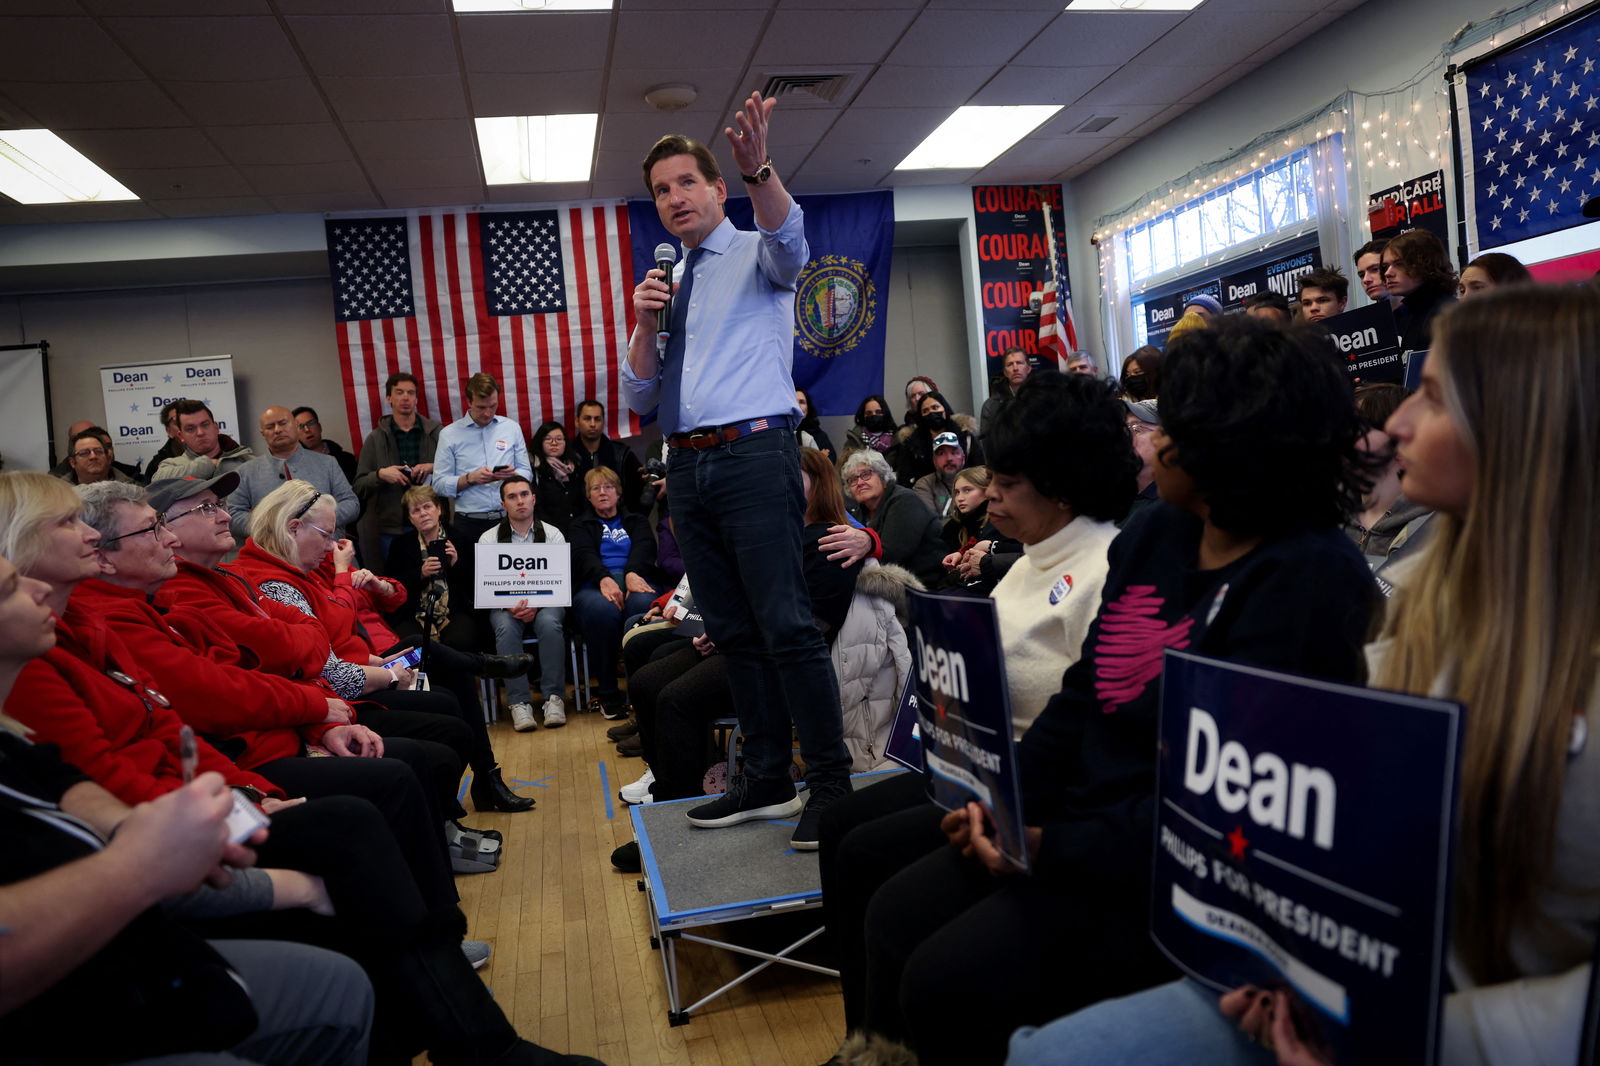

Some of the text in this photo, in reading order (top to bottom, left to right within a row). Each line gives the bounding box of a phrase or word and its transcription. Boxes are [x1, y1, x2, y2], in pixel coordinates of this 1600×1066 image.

[1411, 194, 1444, 218] ALL
[1267, 253, 1314, 276] EVERYONE'S
[1229, 282, 1257, 301] Dean
[1151, 307, 1175, 323] Dean
[1347, 354, 1399, 372] OR PRESIDENT
[113, 372, 149, 384] Dean
[185, 367, 221, 379] Dean
[119, 426, 154, 437] Dean
[498, 554, 548, 570] Dean
[686, 613, 704, 621] PHILL
[915, 625, 970, 702] Dean
[1184, 707, 1336, 850] Dean
[1160, 825, 1400, 978] PHILLIPS FOR PRESIDENT
